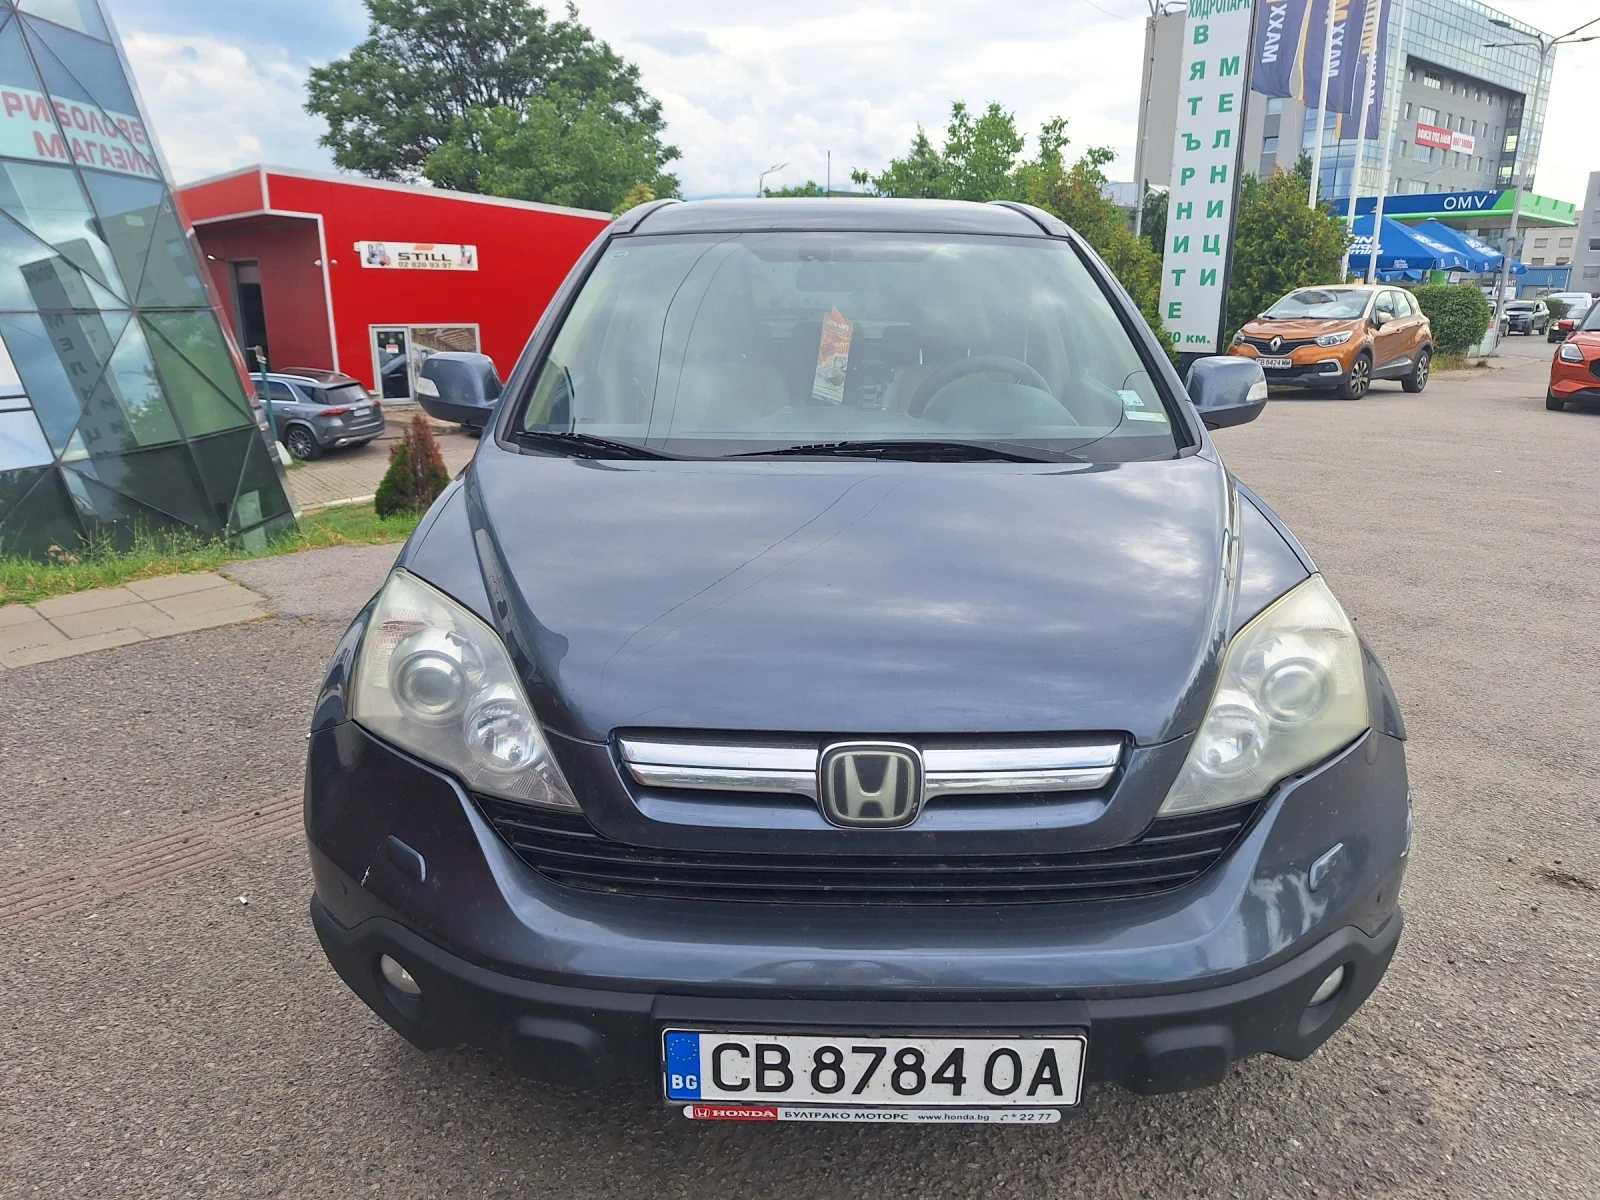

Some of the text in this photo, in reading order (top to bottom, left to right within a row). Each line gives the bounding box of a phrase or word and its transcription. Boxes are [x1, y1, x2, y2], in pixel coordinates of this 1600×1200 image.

[1168, 24, 1210, 319] ВЯТЪРНИТЕ
[1200, 56, 1240, 287] МЕЛНИЦИ
[1443, 195, 1488, 210] OMV
[398, 252, 452, 262] STILL
[1186, 335, 1211, 344] км.
[712, 1042, 794, 1092] CB
[810, 1045, 967, 1096] 8784
[671, 1074, 698, 1090] BG
[712, 1109, 777, 1118] HONDA
[784, 1111, 909, 1121] БУЛТРАКО МОТОРС
[917, 1112, 990, 1122] www.honda.bg
